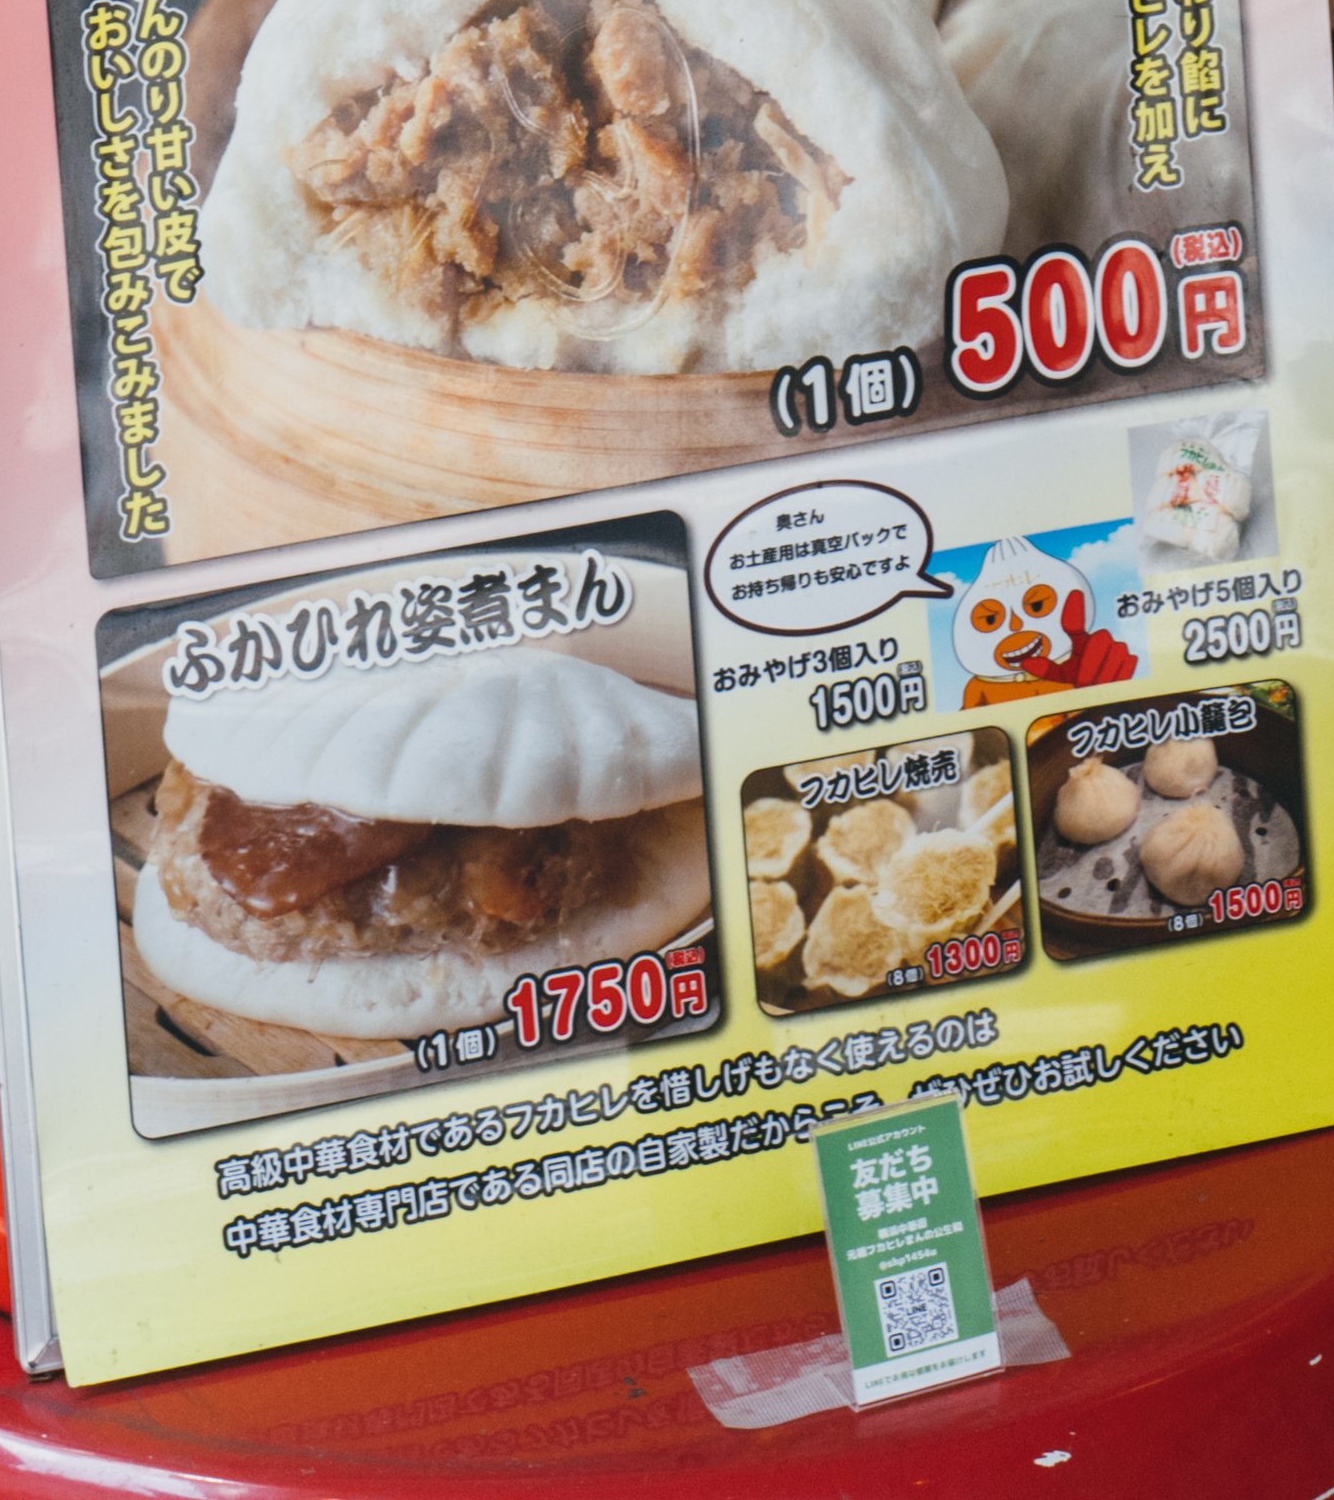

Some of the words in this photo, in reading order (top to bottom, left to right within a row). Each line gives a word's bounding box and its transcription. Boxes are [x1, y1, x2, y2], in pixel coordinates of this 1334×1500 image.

[86, 6, 168, 537] おいしさを包みこみました
[1171, 226, 1241, 269] (税込)
[951, 238, 1248, 392] 500円
[777, 353, 916, 430] (1個)
[776, 508, 825, 531] 奥さん
[731, 555, 910, 601] お持ち帰りも安心ですよ
[1117, 569, 1302, 619] おみやげ5個入り
[168, 555, 625, 695] ふかひれ姿煮まん
[1183, 610, 1302, 666] 2500円
[713, 637, 899, 693] おみやげ3個入り
[810, 672, 927, 731] 1500円
[800, 748, 958, 807] フカヒレ焼売
[1209, 880, 1302, 923] 1500円
[926, 931, 1021, 978] 1300円
[507, 953, 708, 1048] 1750円
[417, 1027, 496, 1070] (1個)
[216, 1009, 998, 1198] 高級中華食材であるフカヒレを惜しげもなく使えるのは
[850, 1144, 933, 1189] 友だち
[855, 1176, 940, 1222] 募集中
